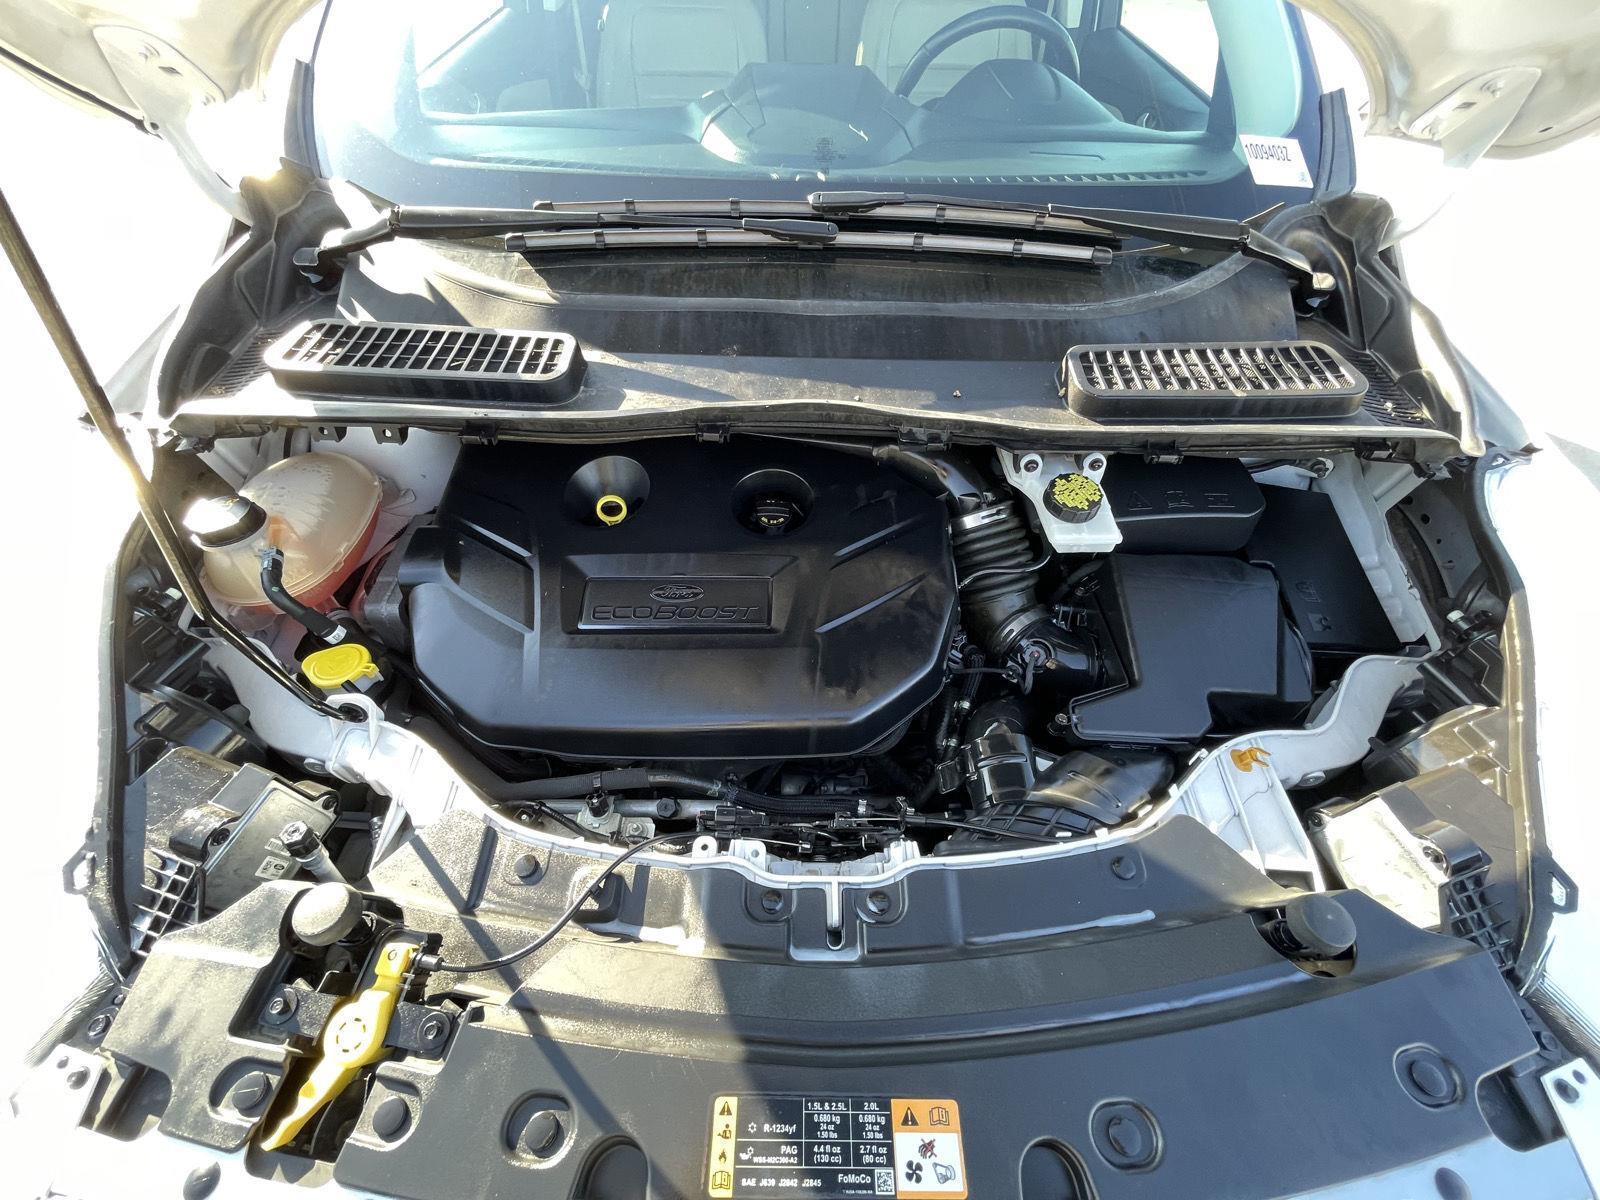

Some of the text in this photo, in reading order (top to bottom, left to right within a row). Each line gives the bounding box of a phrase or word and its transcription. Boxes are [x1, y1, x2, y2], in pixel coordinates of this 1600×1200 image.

[807, 1102, 847, 1110] 1.5L & 2.5L
[863, 1102, 880, 1110] 2.0L
[831, 1113, 841, 1125] kg
[876, 1114, 886, 1125] kg
[763, 1124, 797, 1134] R-1234yf
[780, 1145, 798, 1154] PAG
[813, 1144, 824, 1153] 4.4
[859, 1145, 871, 1154] 2.7
[813, 1154, 842, 1165] (130 cc)
[875, 1155, 887, 1165] cc)
[838, 1173, 872, 1184] FoMoCo
